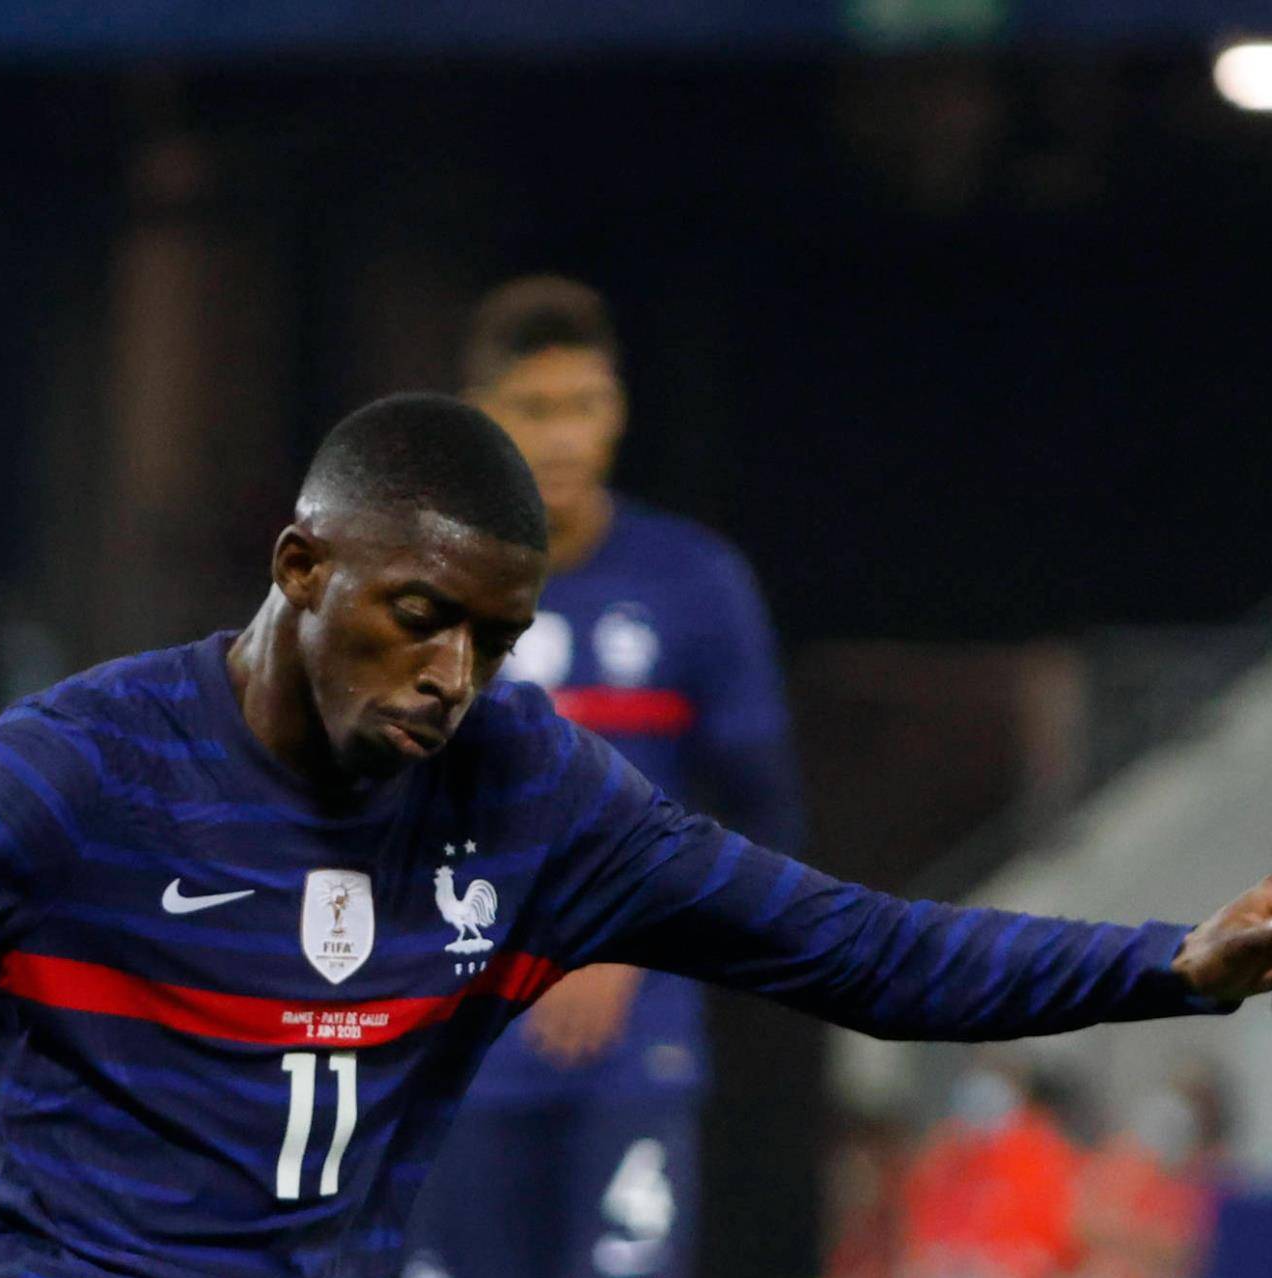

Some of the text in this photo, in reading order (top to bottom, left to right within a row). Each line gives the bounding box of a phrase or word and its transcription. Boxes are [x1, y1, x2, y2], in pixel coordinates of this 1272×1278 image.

[323, 941, 351, 953] FIFA
[282, 1011, 314, 1024] FRANCE
[346, 1011, 358, 1024] DE
[306, 1024, 362, 1039] 2 JUIN 2021
[276, 1053, 357, 1199] 11
[601, 1138, 675, 1240] 4
